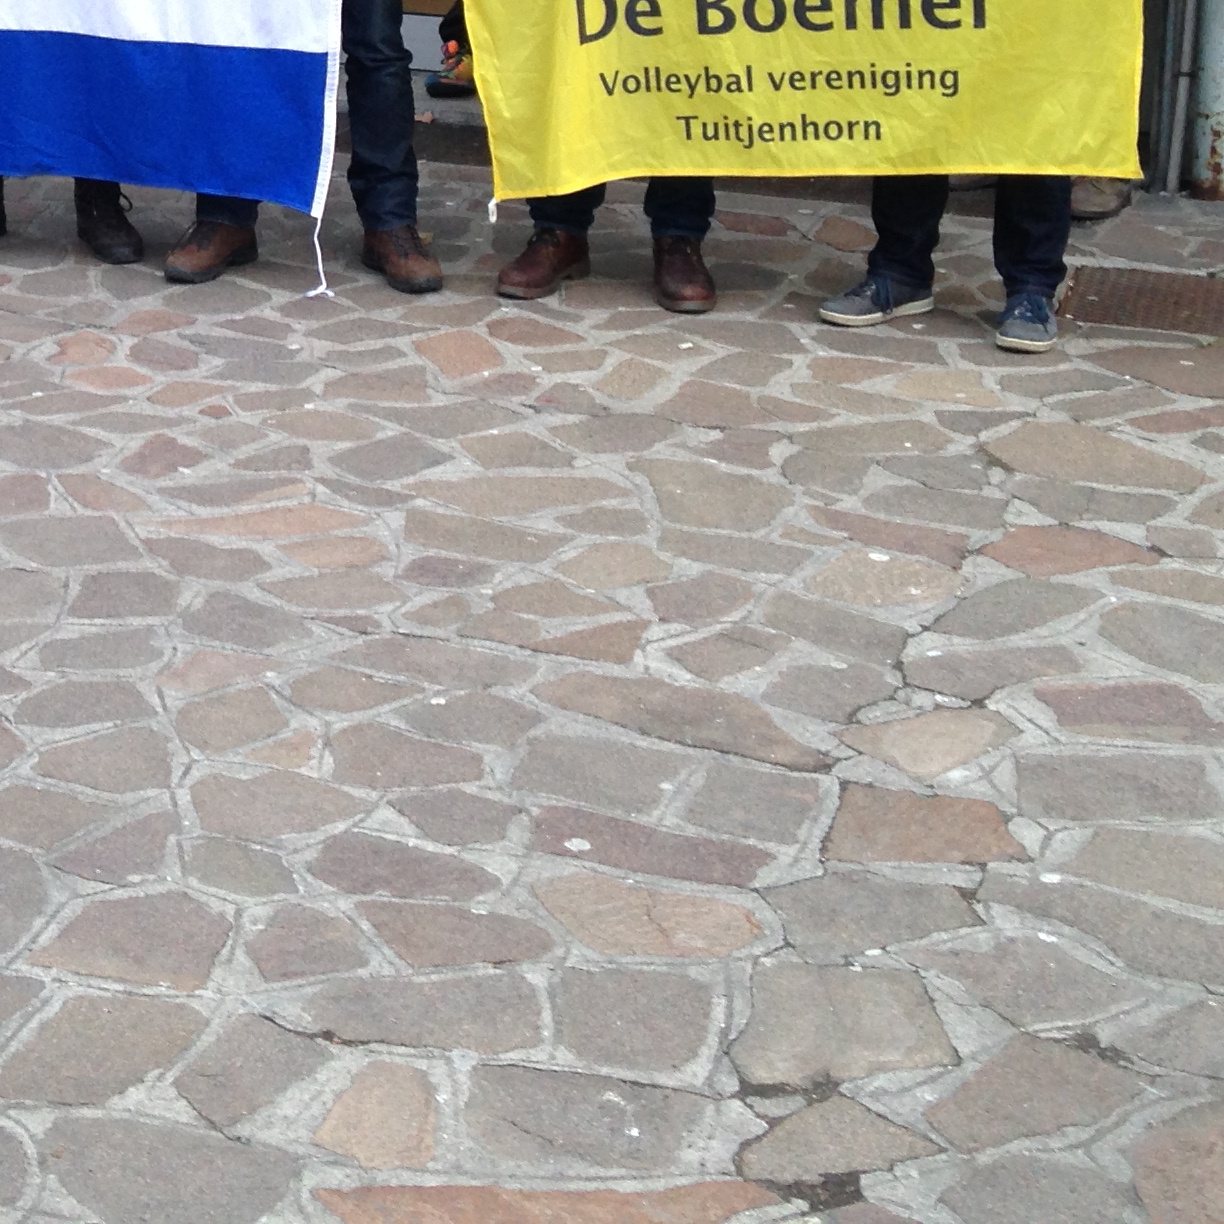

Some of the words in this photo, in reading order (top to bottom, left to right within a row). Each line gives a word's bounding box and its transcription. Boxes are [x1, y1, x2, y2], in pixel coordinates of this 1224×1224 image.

[599, 64, 754, 100] Volleybal
[767, 62, 959, 98] vereniging
[675, 113, 882, 150] Tuitjenhorn
